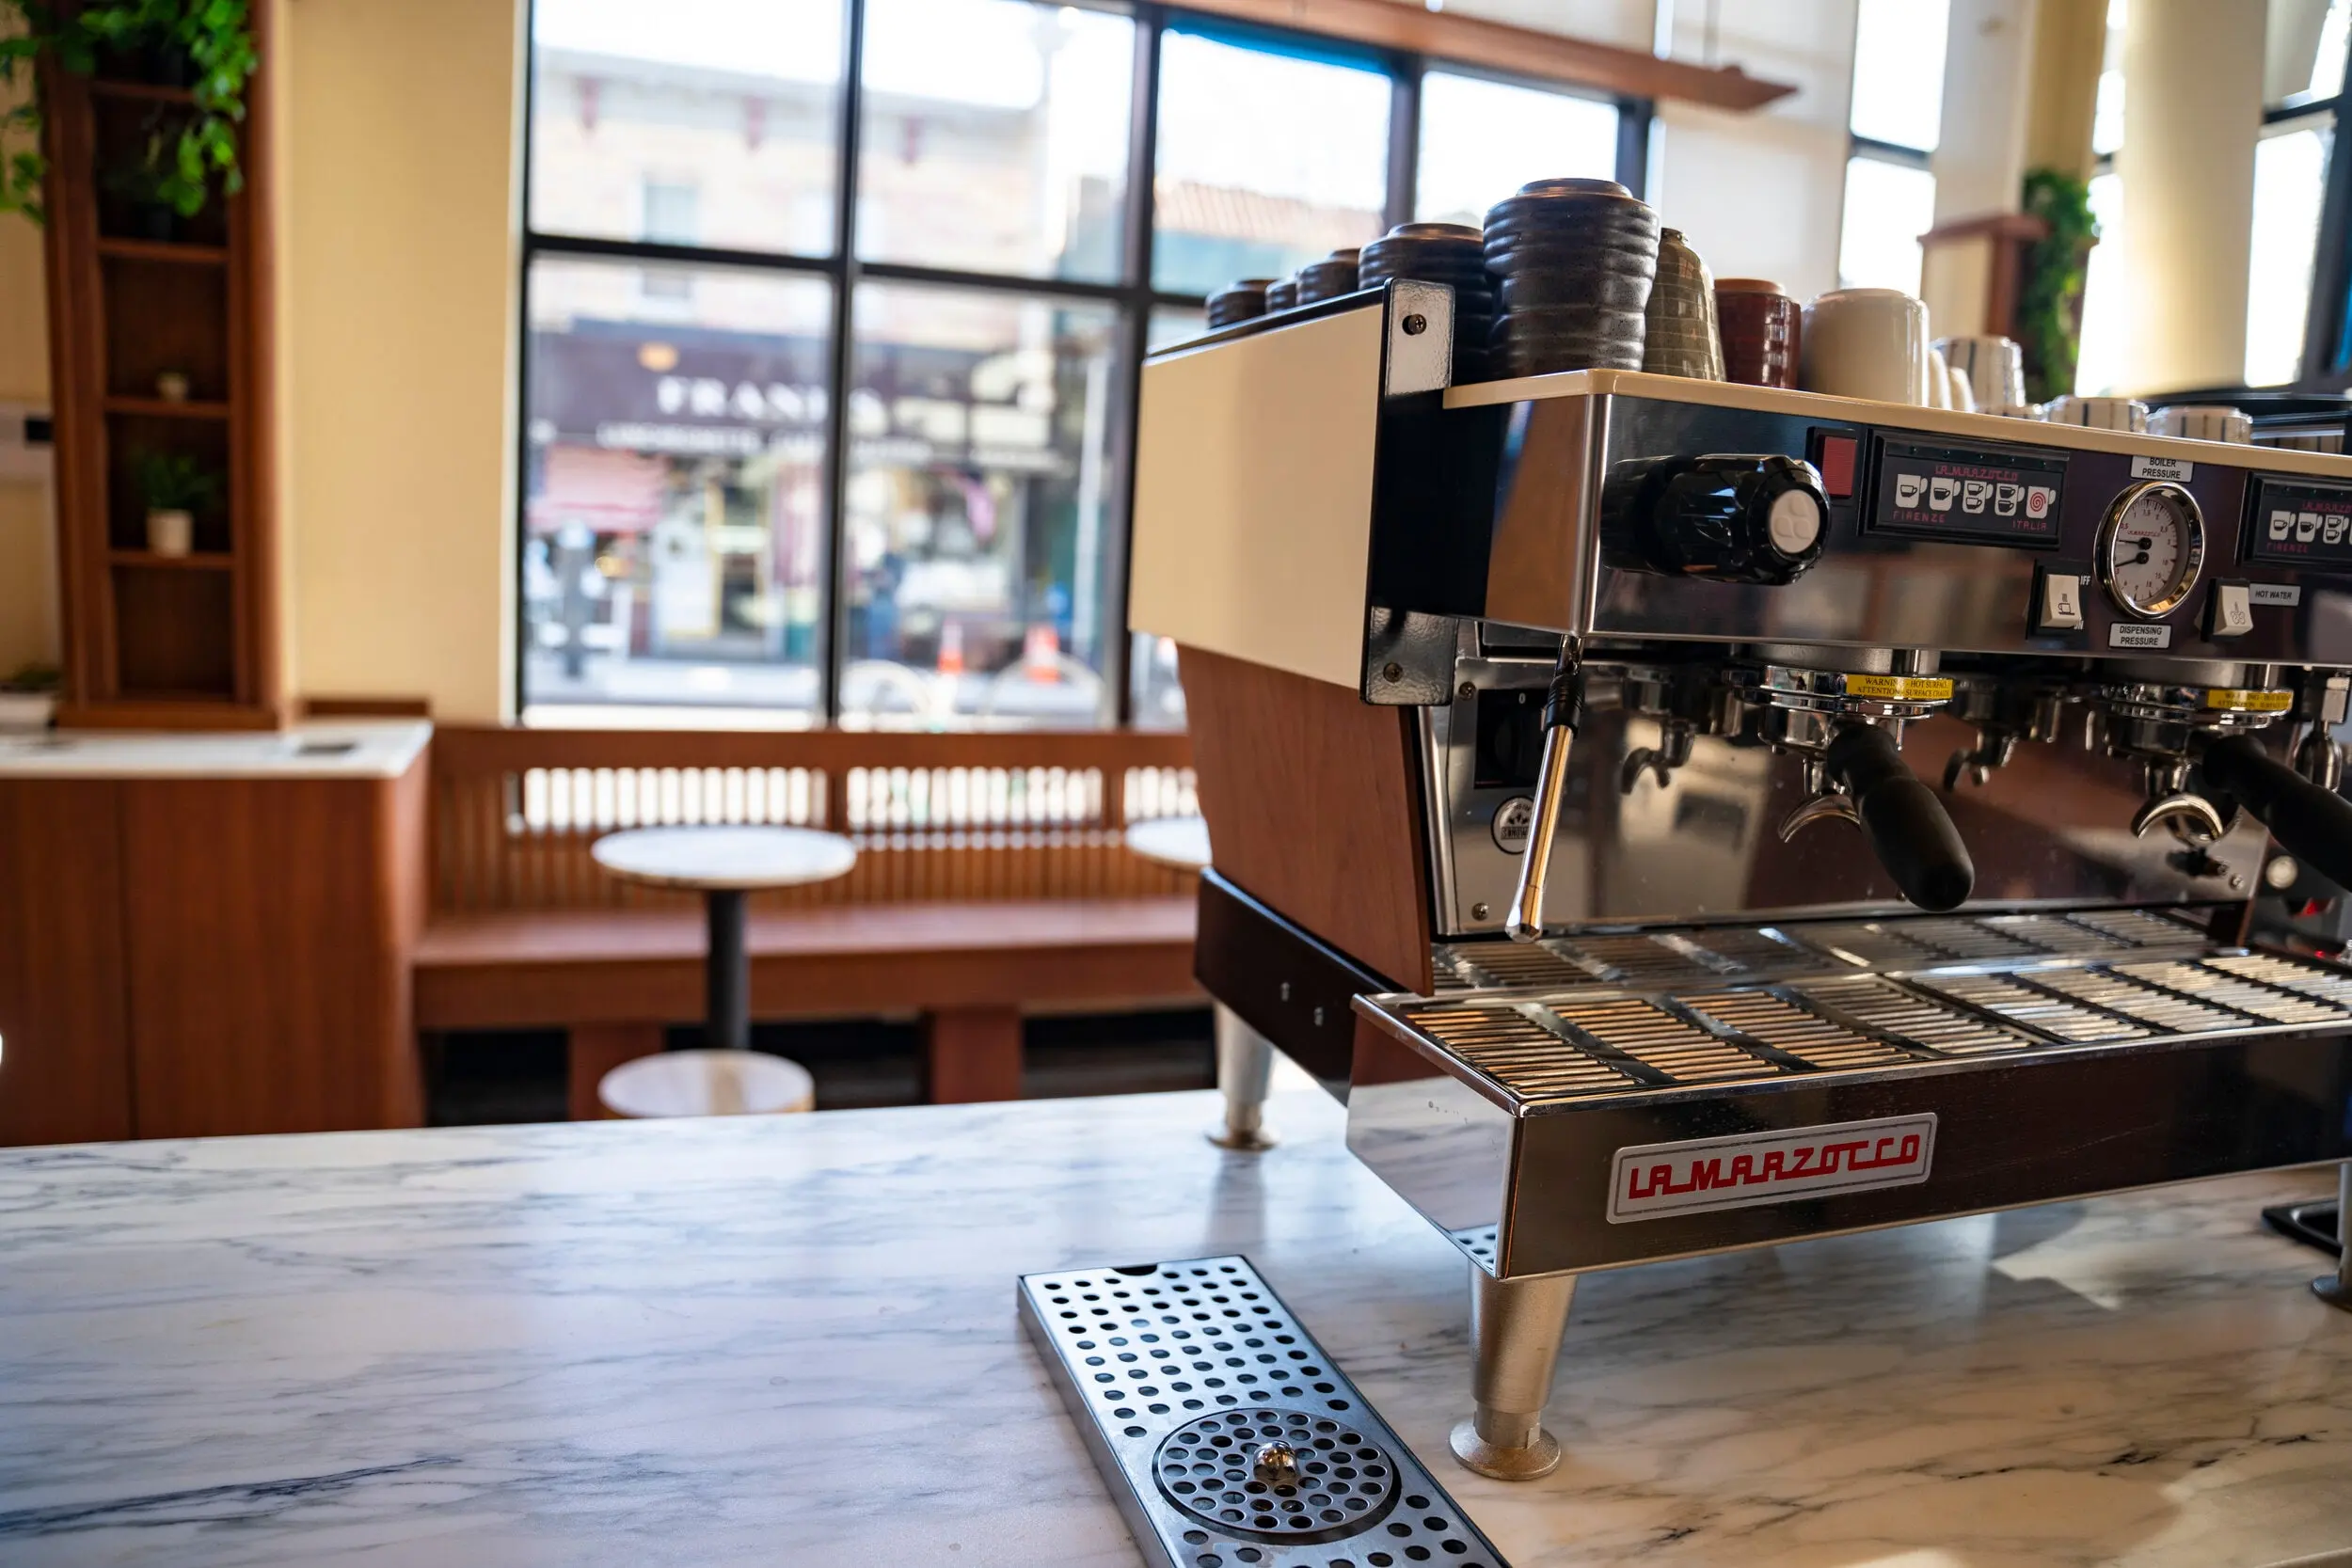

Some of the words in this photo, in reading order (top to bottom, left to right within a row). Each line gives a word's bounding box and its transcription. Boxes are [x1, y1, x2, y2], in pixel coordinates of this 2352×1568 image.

[2150, 457, 2176, 467] BOILER
[2142, 468, 2181, 479] PRESSURE
[1893, 511, 1946, 523] FIRENZE
[2012, 520, 2047, 531] ITALIA
[2267, 542, 2308, 553] FIRENZE
[2270, 592, 2292, 600] WATER
[2120, 626, 2162, 635] DISPENSING
[2121, 637, 2158, 645] PRESSURE
[1911, 680, 1924, 689] HOT
[1691, 1133, 1921, 1190] MARZOCCO
